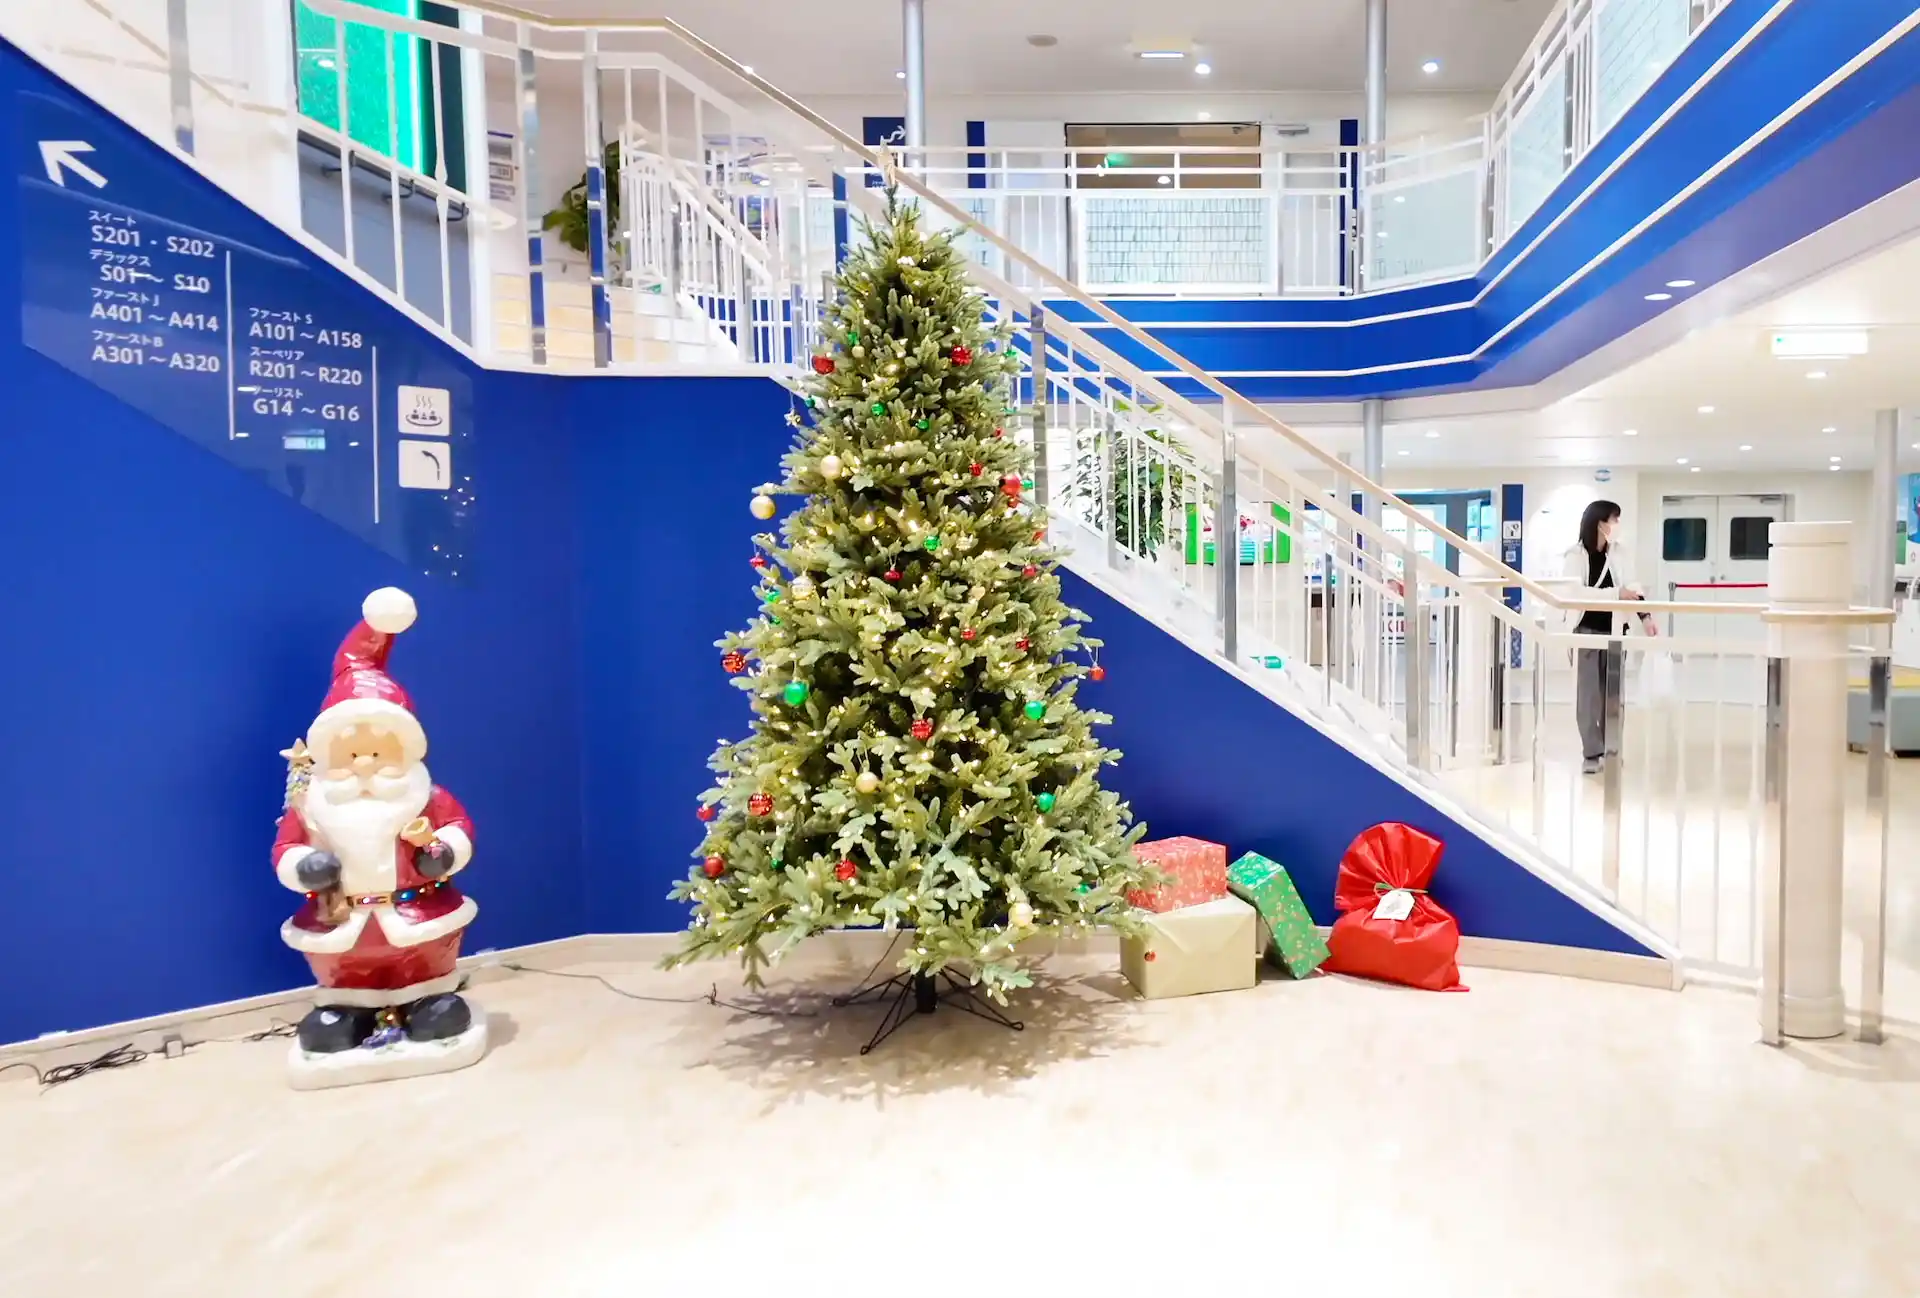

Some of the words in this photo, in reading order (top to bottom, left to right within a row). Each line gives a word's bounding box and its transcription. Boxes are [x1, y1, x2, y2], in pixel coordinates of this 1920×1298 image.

[88, 210, 136, 226] スイート
[89, 249, 151, 267] デラックス
